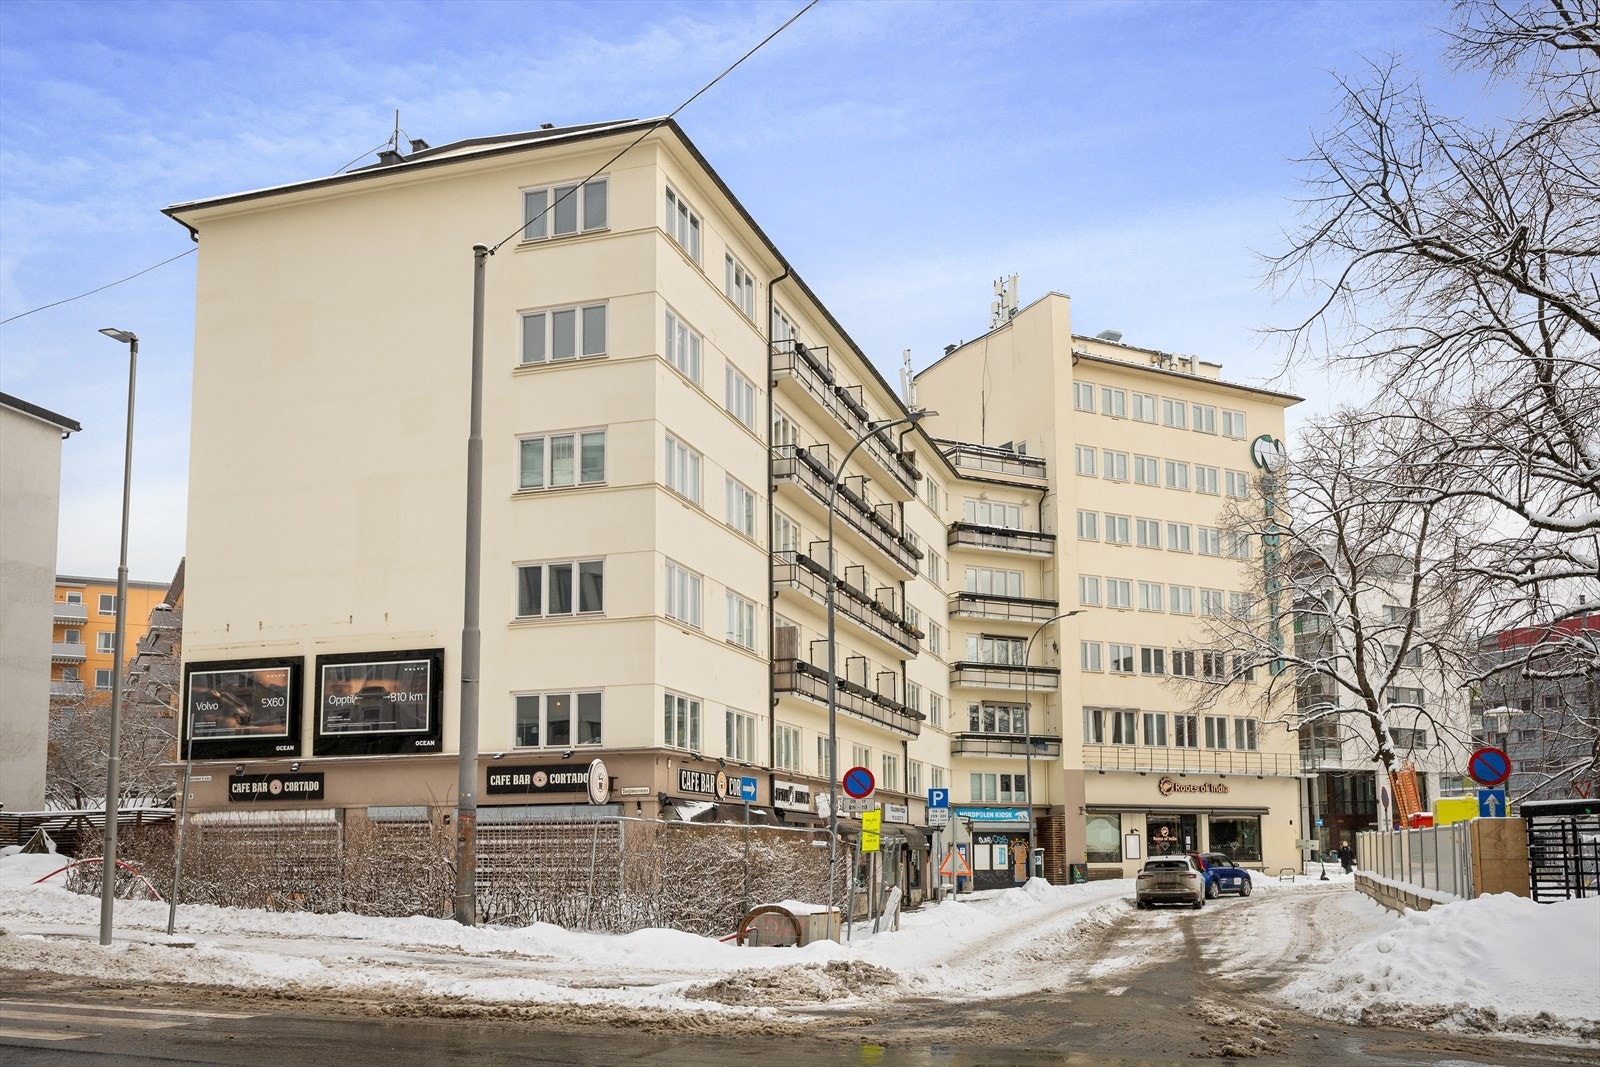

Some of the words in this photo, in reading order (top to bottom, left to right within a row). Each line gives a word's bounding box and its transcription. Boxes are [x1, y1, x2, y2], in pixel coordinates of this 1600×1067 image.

[409, 692, 423, 701] km
[196, 701, 219, 711] Volvo
[490, 774, 511, 786] CAFE
[513, 774, 530, 786] BAR
[550, 772, 588, 784] CORTADO
[681, 770, 700, 792] CAFE
[700, 773, 715, 793] BAR
[728, 778, 741, 796] COR
[232, 782, 250, 793] CAFE
[252, 782, 268, 792] BAR
[284, 780, 320, 792] CORTADO
[1174, 782, 1200, 792] Roots
[1200, 782, 1209, 792] of
[1210, 783, 1230, 794] India
[933, 791, 944, 806] P
